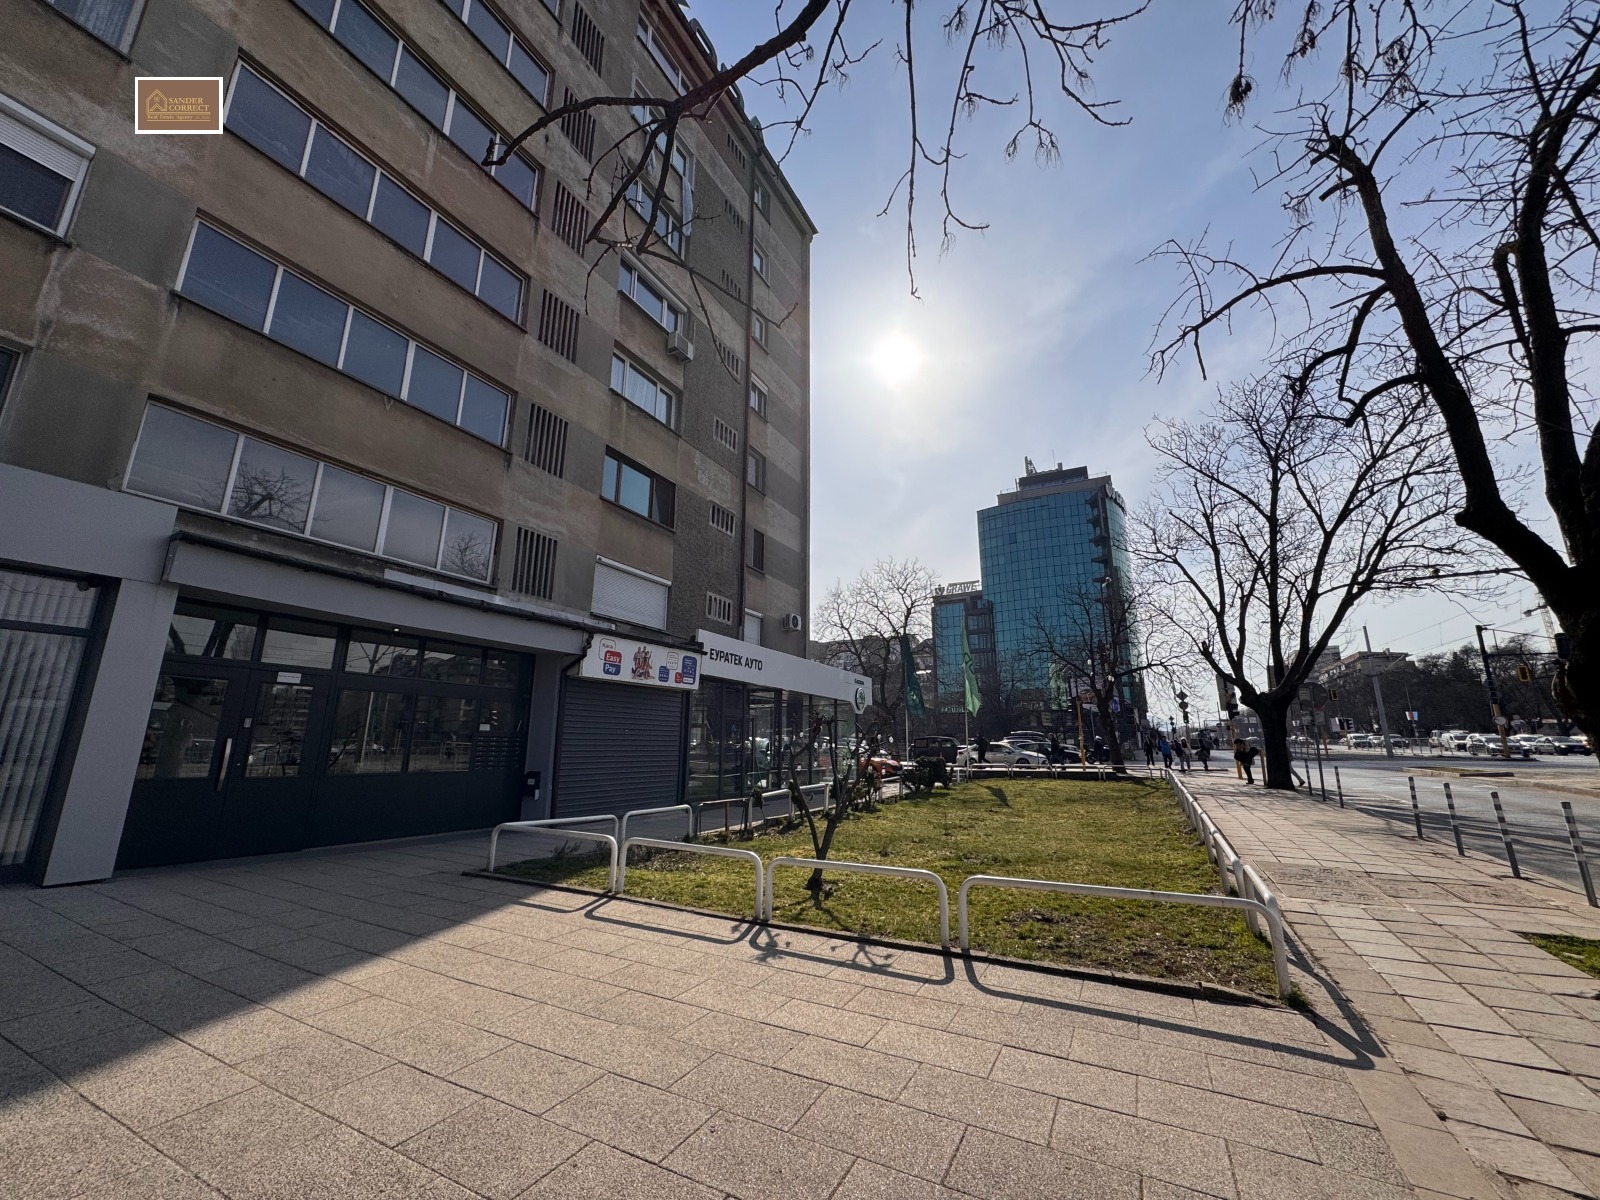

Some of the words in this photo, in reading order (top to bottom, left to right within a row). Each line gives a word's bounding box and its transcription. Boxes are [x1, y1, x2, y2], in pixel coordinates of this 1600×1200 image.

[606, 653, 620, 663] Easy
[710, 648, 743, 667] ЕУРАТЕК
[744, 657, 763, 671] АУТО
[605, 664, 616, 673] Pay
